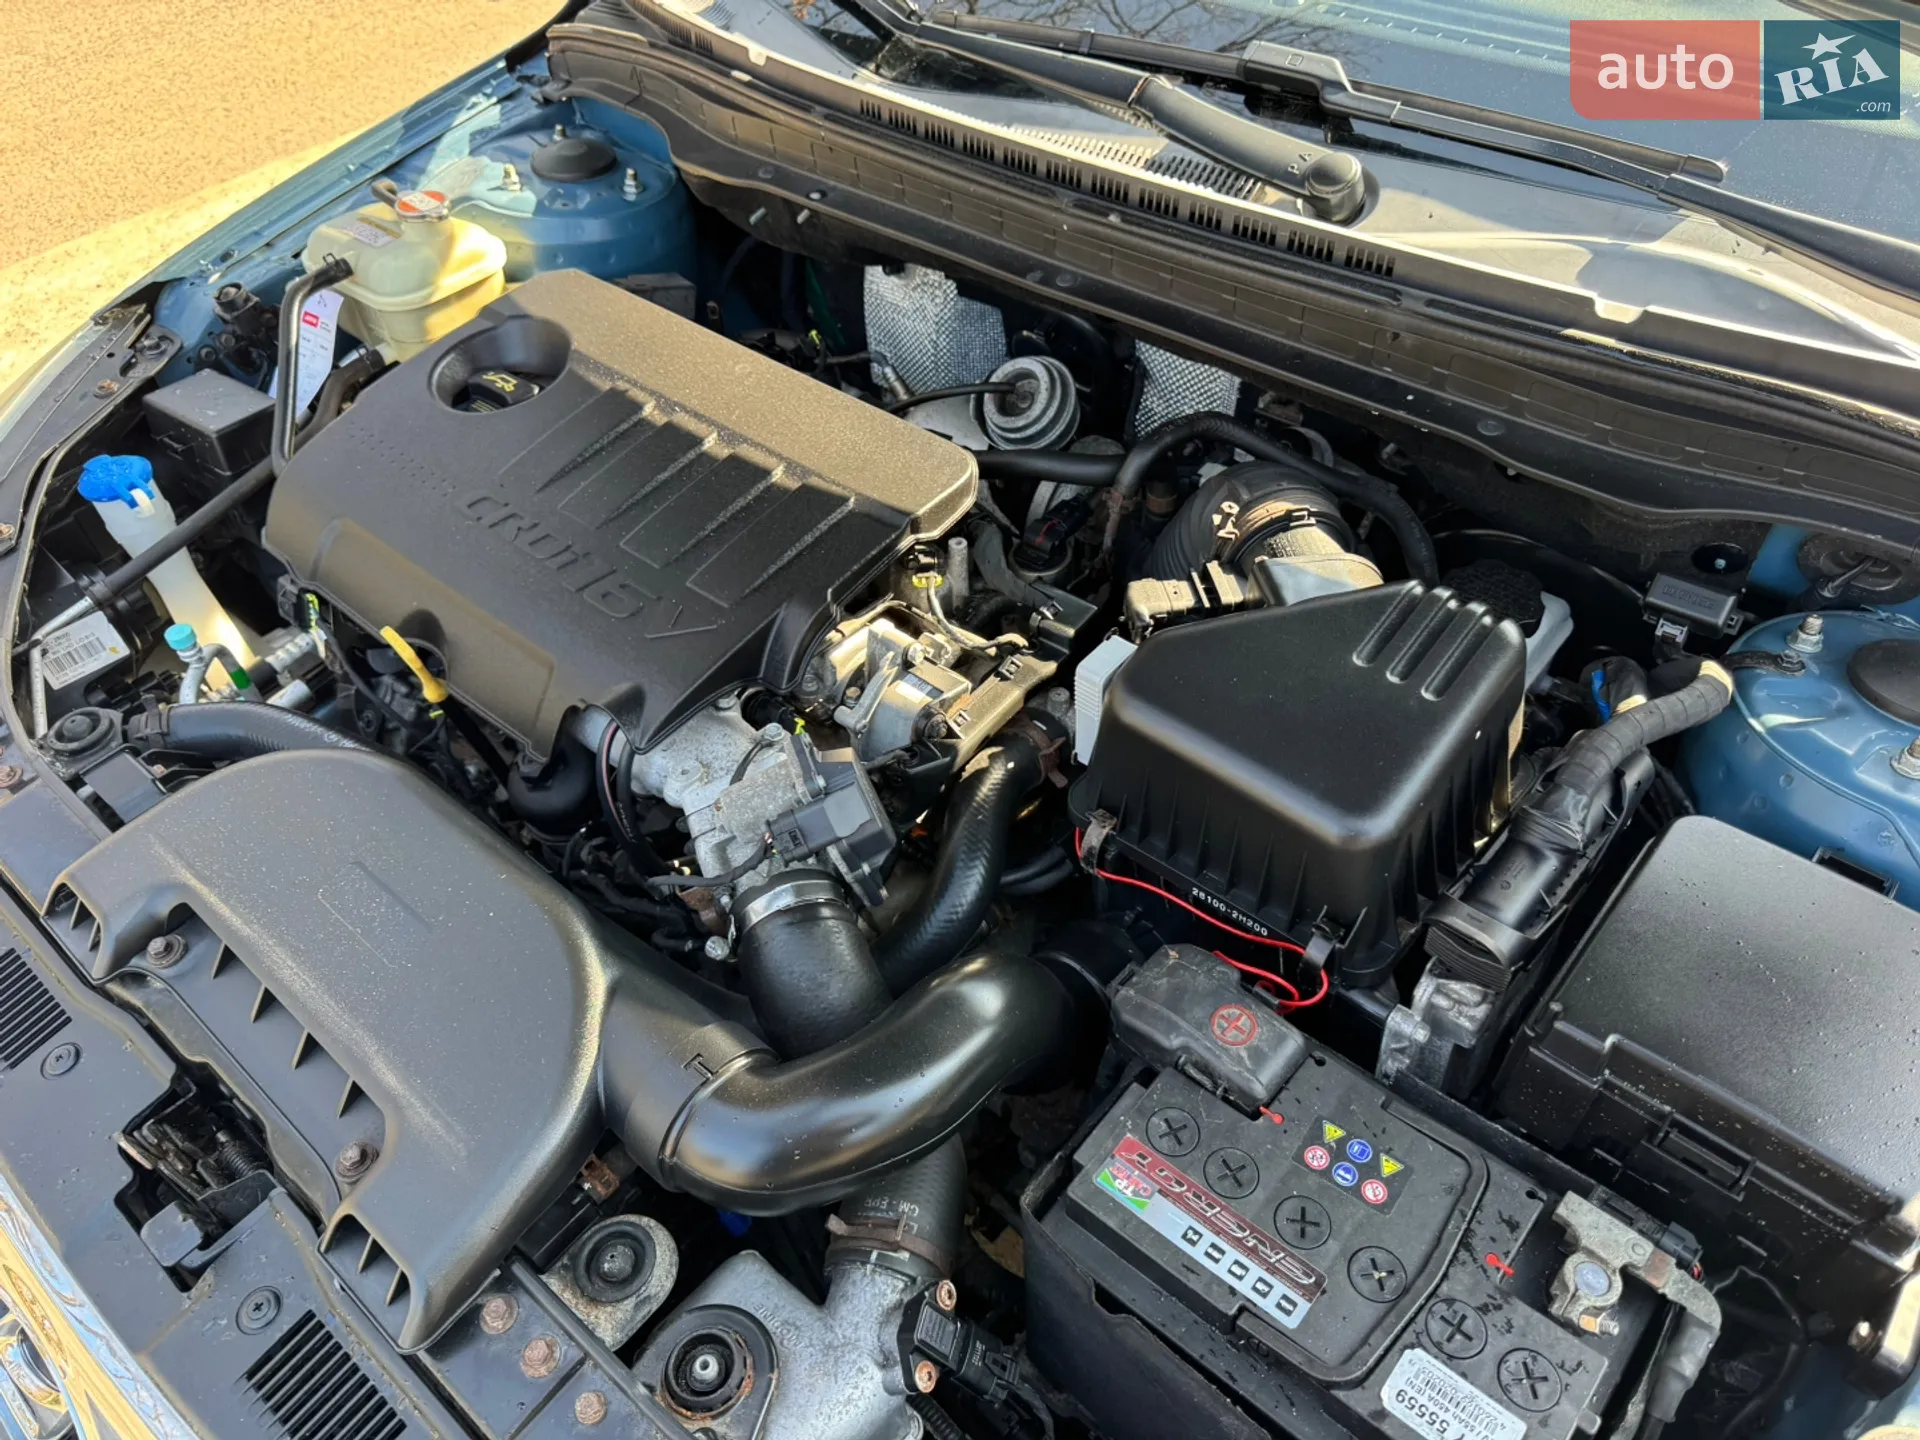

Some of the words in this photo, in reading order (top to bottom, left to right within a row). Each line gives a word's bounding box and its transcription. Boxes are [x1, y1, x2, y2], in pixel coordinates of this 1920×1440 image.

[1120, 1151, 1316, 1284] ENERGY
[1395, 1388, 1450, 1435] 55559
[1427, 1393, 1451, 1414] 450A
